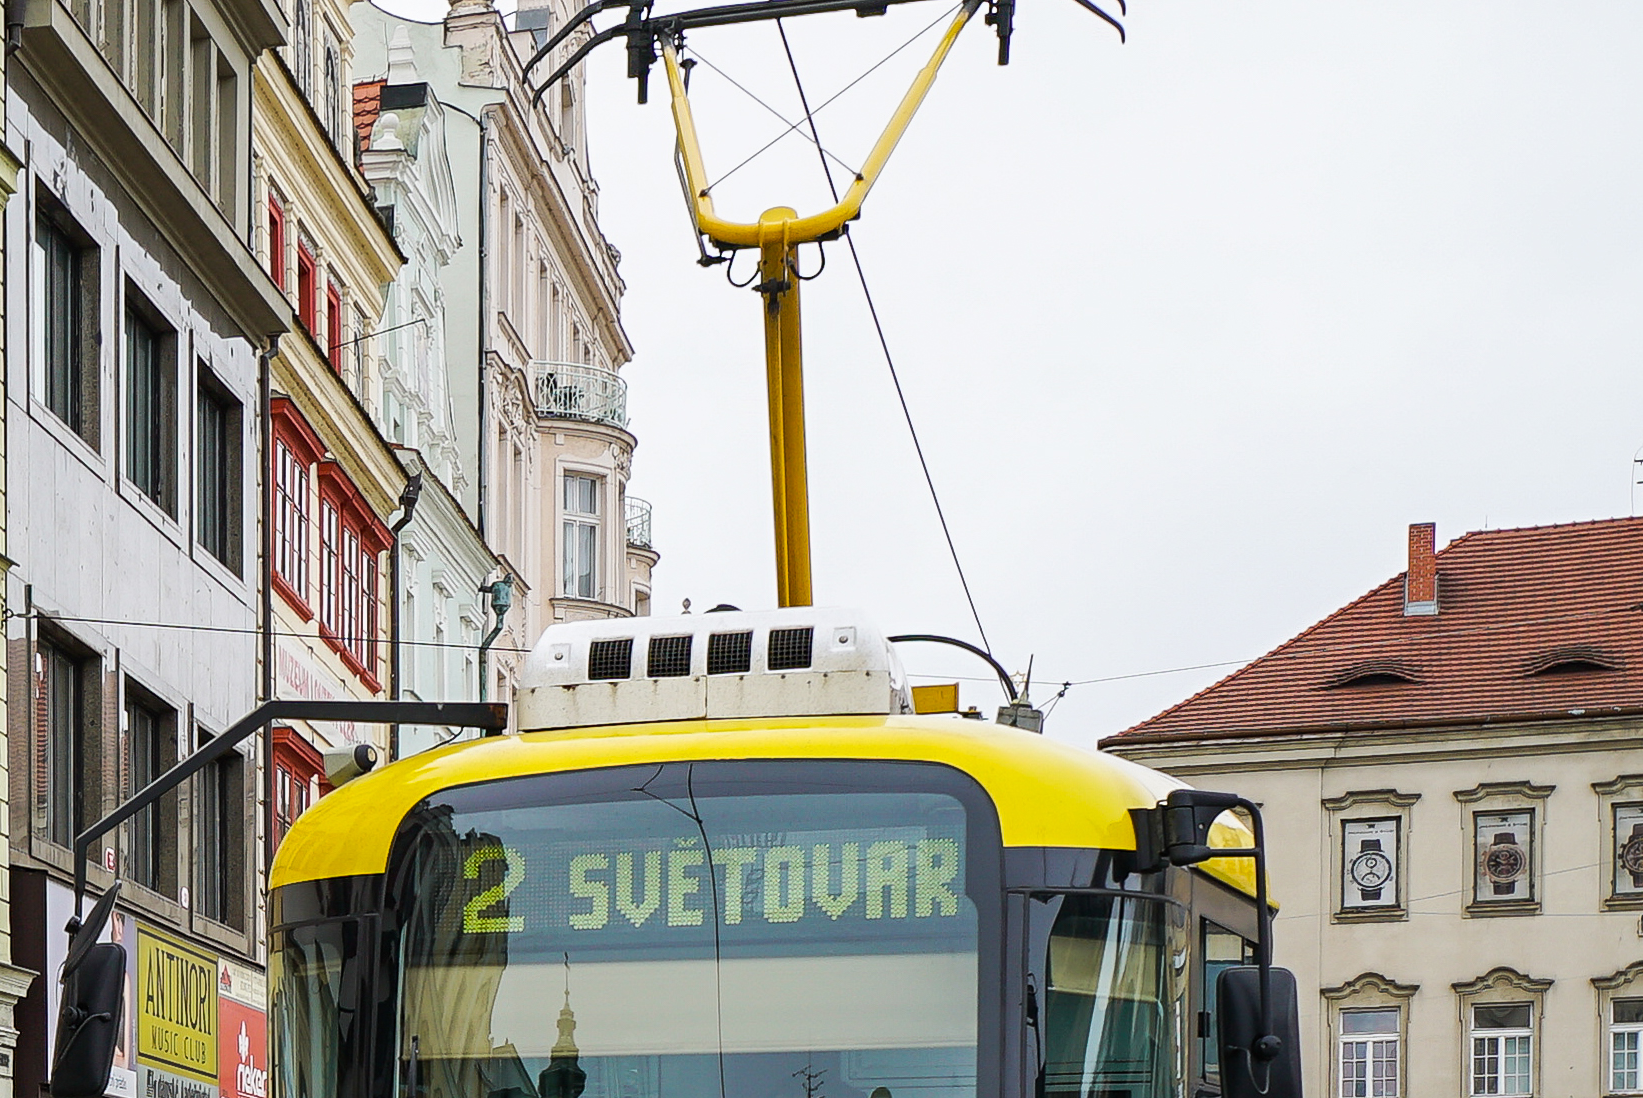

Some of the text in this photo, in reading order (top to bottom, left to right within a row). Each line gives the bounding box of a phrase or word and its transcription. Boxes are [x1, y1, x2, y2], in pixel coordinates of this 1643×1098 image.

[463, 837, 959, 933] 2 SVĚTOVAR
[145, 946, 212, 1036] ANTINORI
[151, 1025, 207, 1065] MUSIC CLUB
